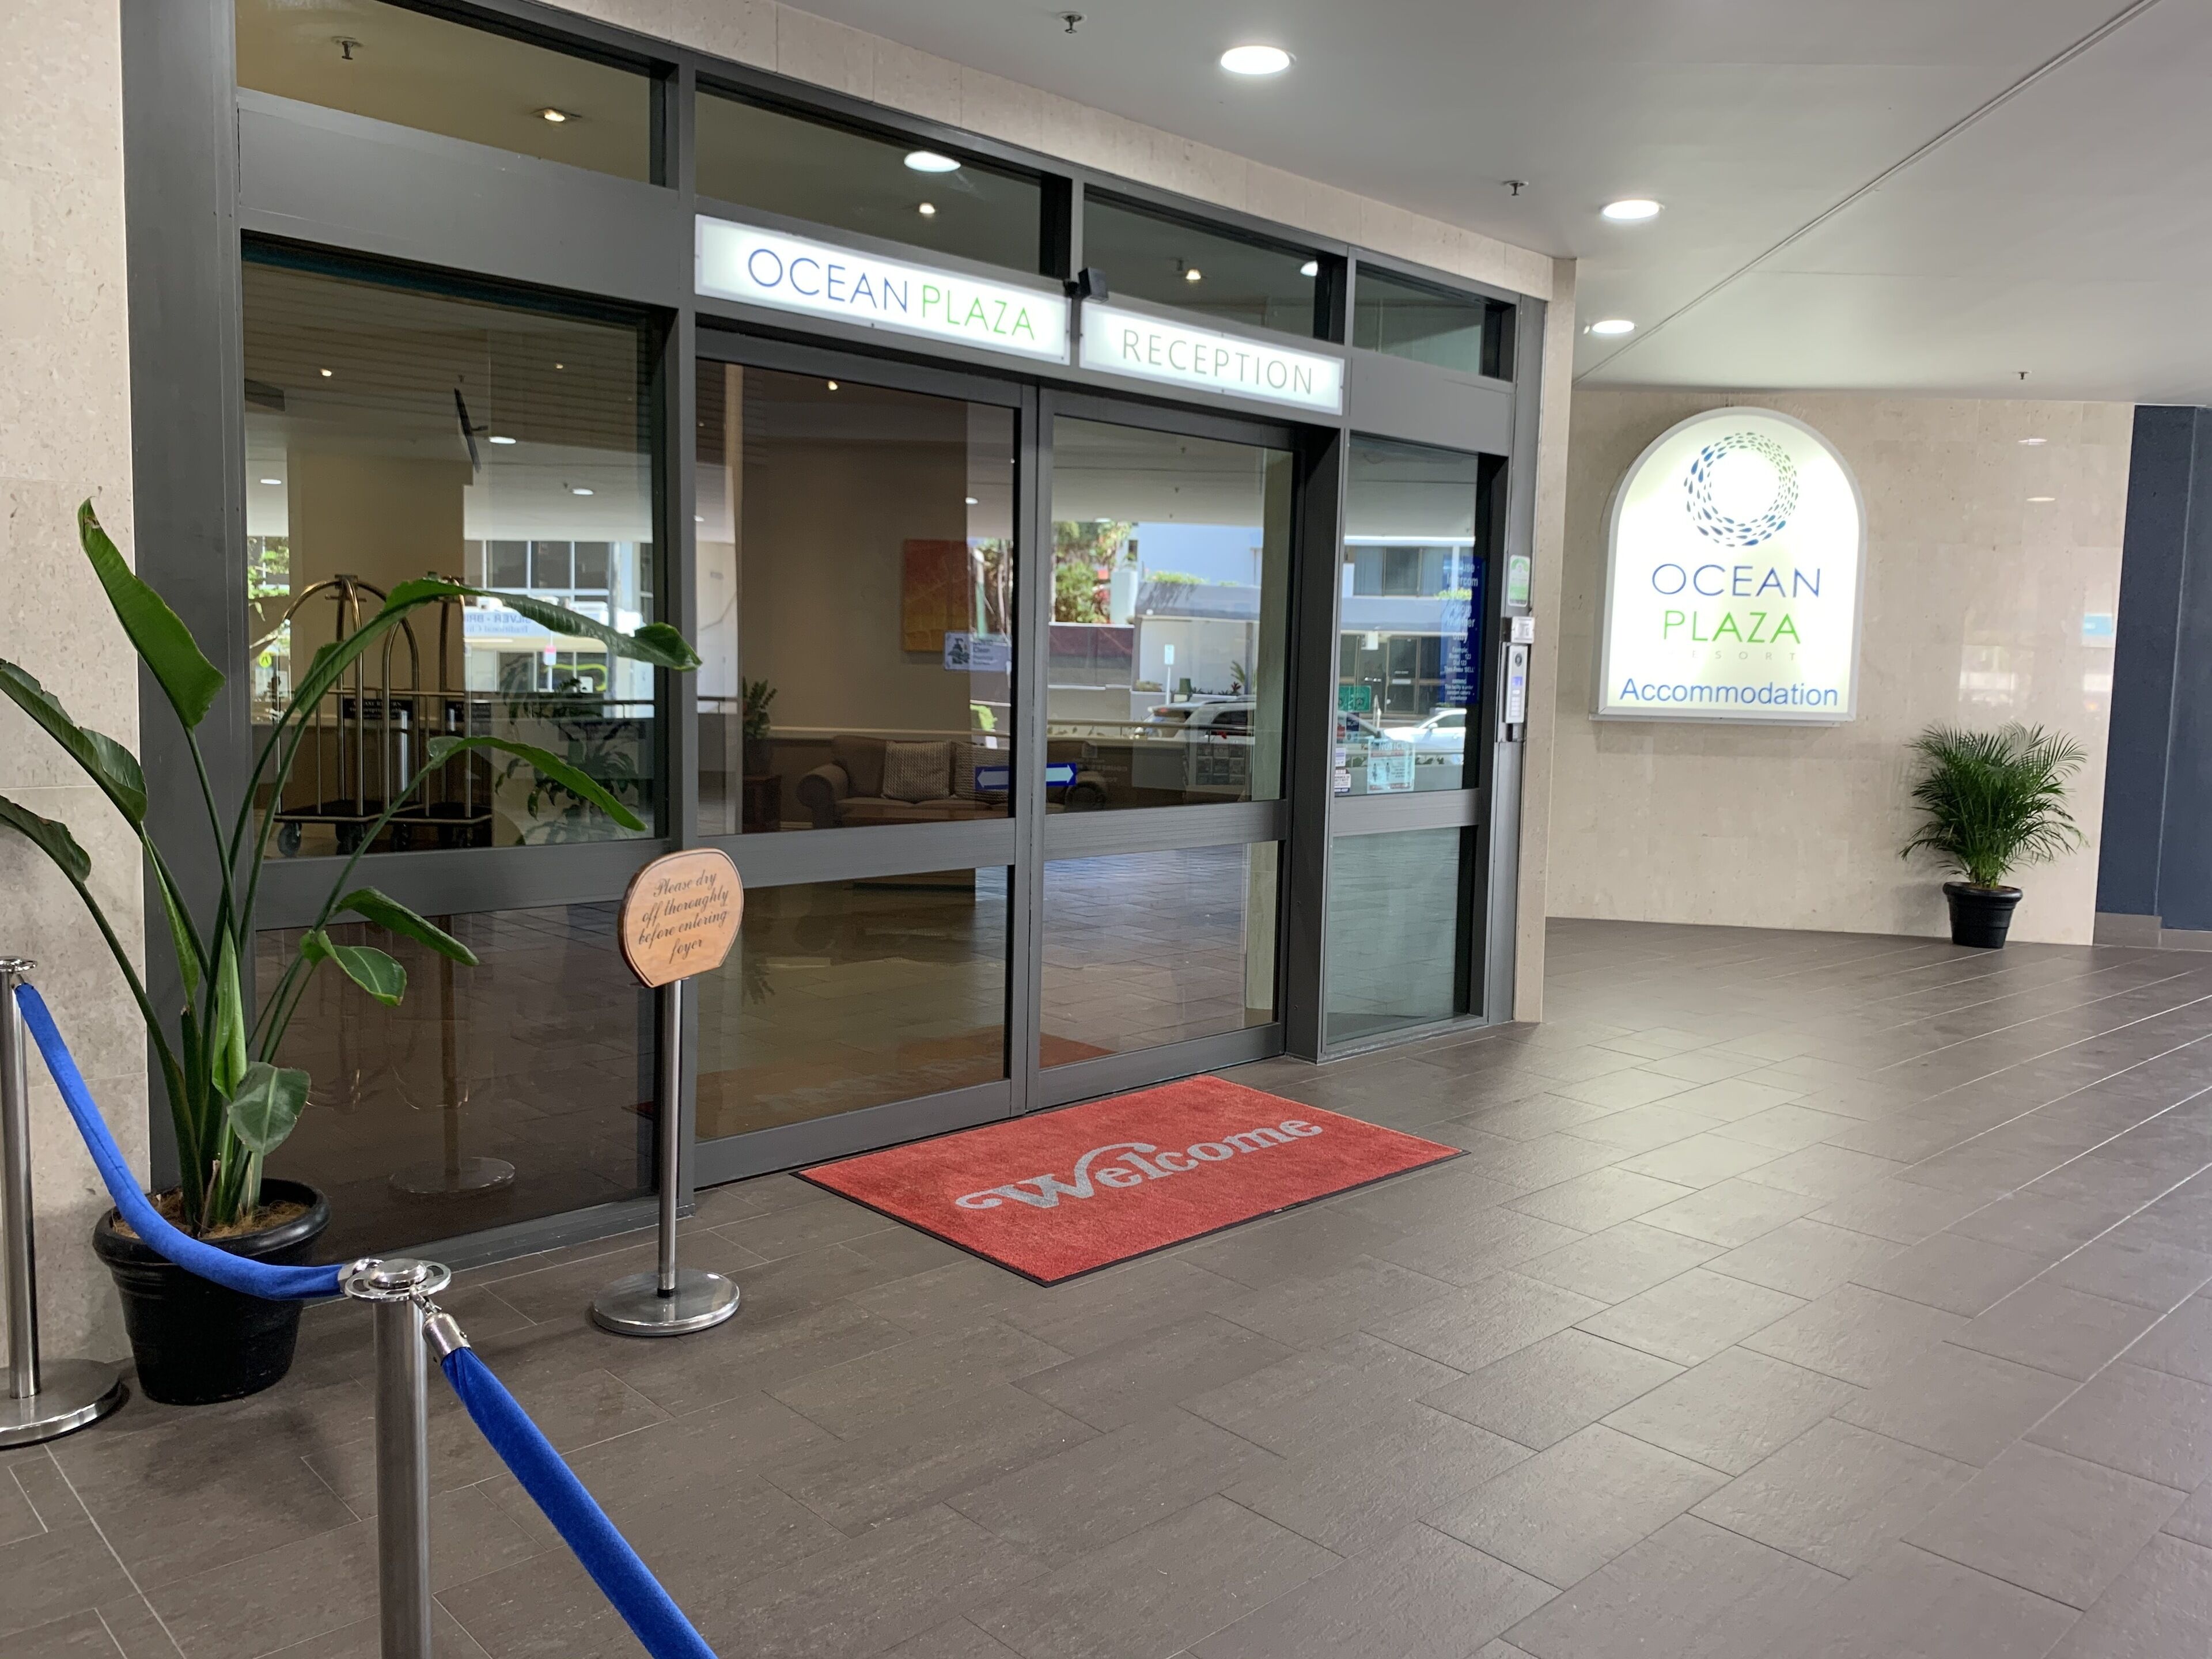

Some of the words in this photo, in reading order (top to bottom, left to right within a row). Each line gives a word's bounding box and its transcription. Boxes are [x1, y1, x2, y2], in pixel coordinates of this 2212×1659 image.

[748, 249, 908, 313] OCEAN
[922, 285, 1035, 340] PLAZA
[1123, 329, 1312, 395] RECEPTION
[1652, 563, 1820, 598] OCEAN
[1664, 610, 1801, 644] PLAZA
[1619, 677, 1839, 706] Accommodation
[653, 878, 693, 897] Please
[696, 869, 717, 891] dry
[642, 900, 663, 928] off
[664, 885, 729, 916] thoroughly
[639, 923, 676, 949] before
[679, 911, 728, 933] entering
[669, 938, 703, 964] foyer
[955, 1119, 1324, 1209] Welcome
